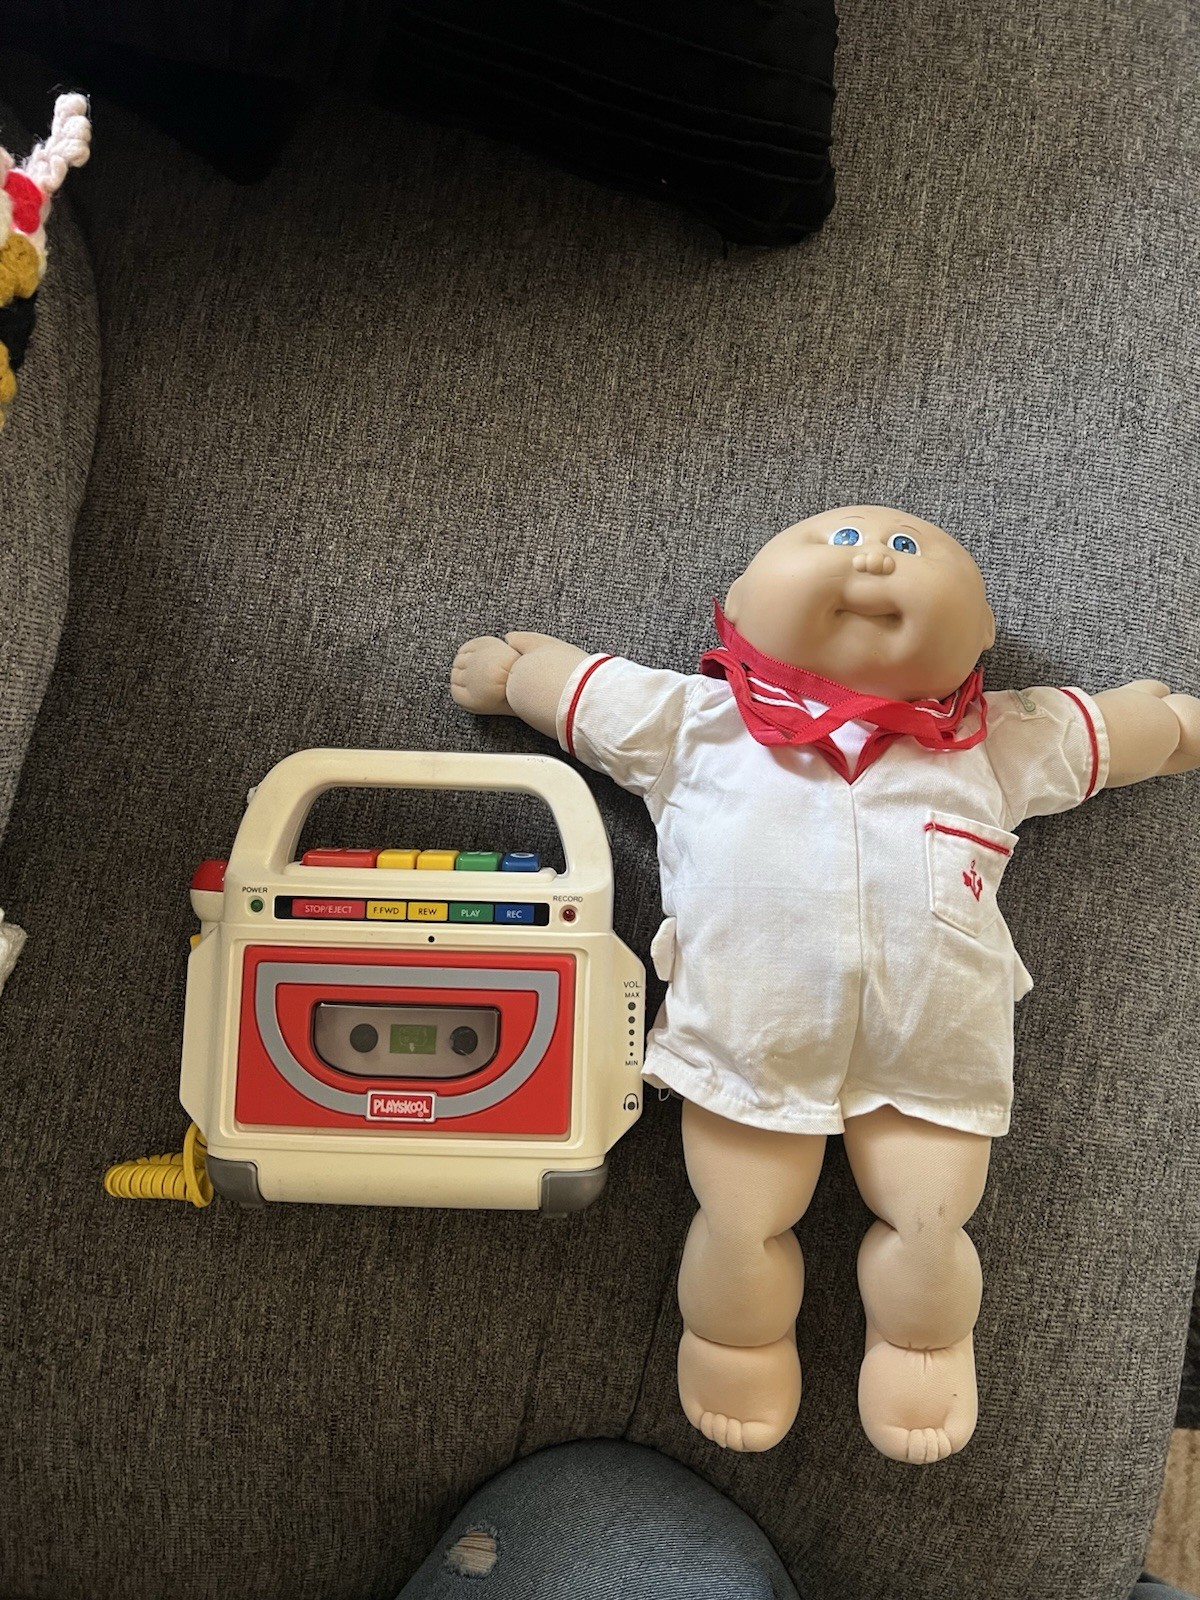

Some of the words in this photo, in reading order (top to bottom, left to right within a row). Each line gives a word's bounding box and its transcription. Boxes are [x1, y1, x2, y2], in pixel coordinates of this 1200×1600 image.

[242, 886, 268, 894] POWER
[552, 895, 584, 903] RECORD
[304, 904, 353, 915] STOP/EJECT
[418, 907, 437, 916] REW
[460, 908, 481, 918] PLAY
[506, 909, 523, 919] REC
[624, 991, 640, 999] MAX
[373, 1098, 430, 1115] PLAYSKOOL
